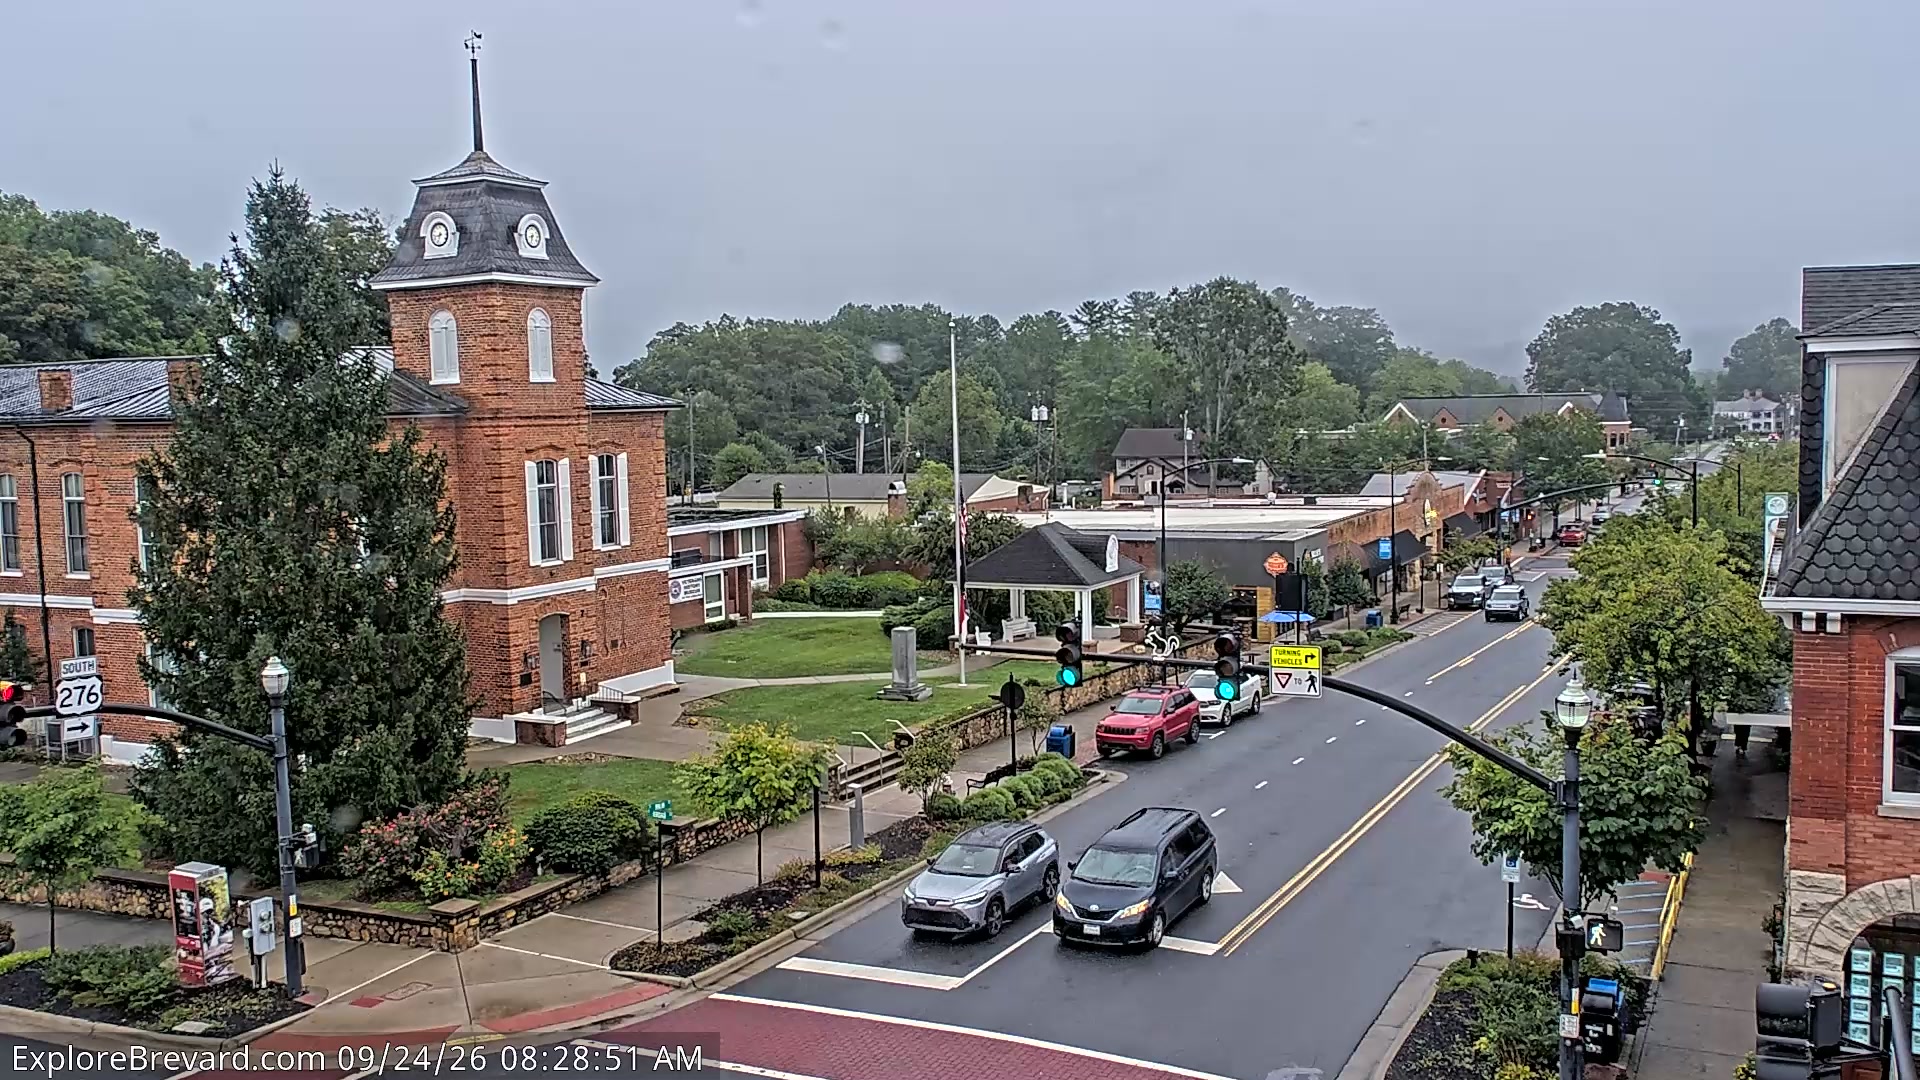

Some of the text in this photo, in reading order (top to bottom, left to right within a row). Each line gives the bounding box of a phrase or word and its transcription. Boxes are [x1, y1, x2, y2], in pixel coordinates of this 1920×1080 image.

[62, 661, 95, 675] SOUTH
[1294, 677, 1303, 685] TO
[60, 684, 99, 708] 276
